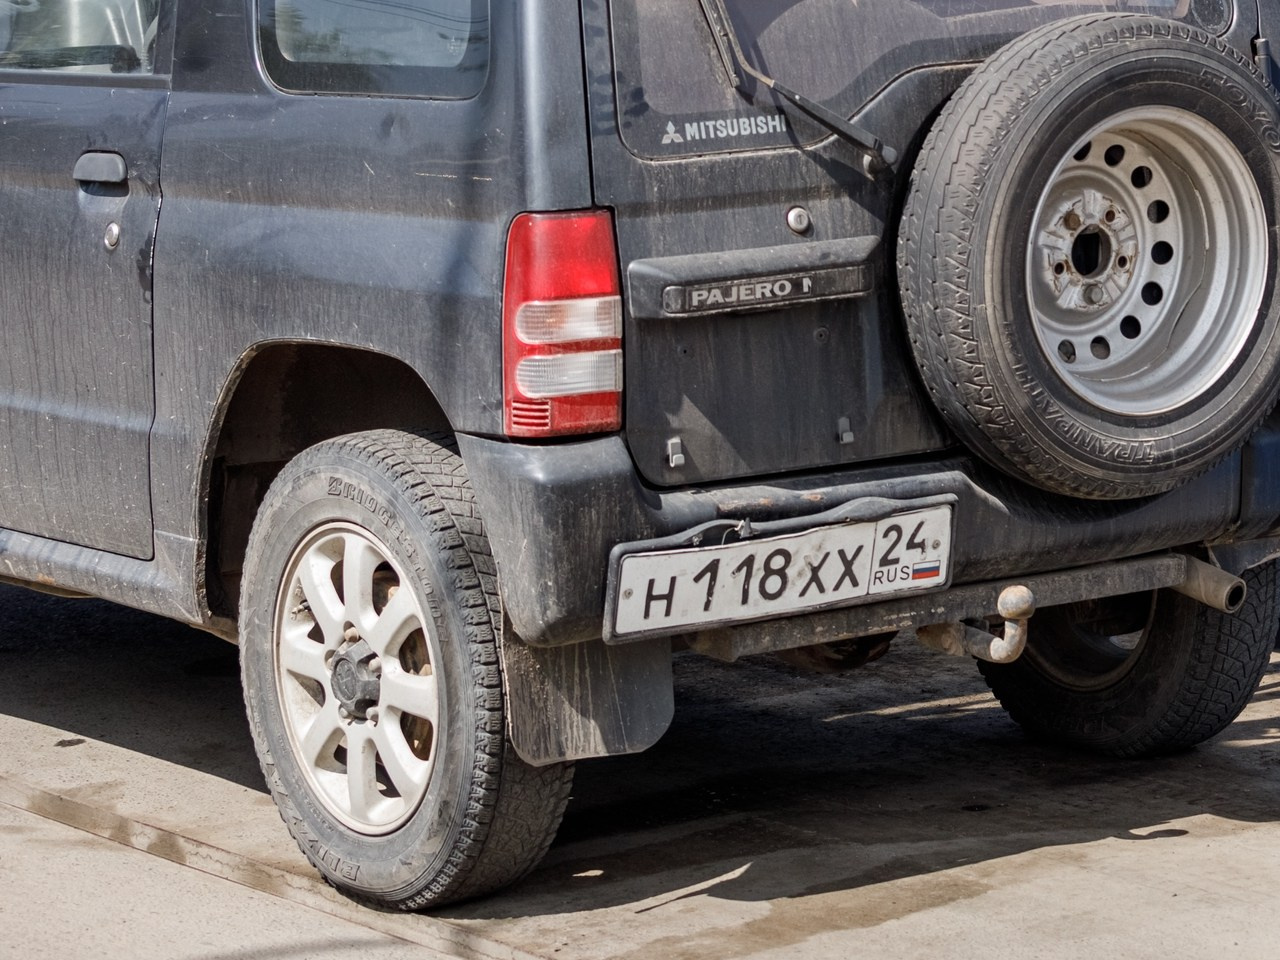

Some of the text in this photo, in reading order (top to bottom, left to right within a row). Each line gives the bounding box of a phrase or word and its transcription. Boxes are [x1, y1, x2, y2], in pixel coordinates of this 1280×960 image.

[684, 114, 787, 141] MITSUBISHI
[692, 280, 792, 306] PAJERO
[878, 520, 928, 567] 24
[872, 565, 911, 586] RUS
